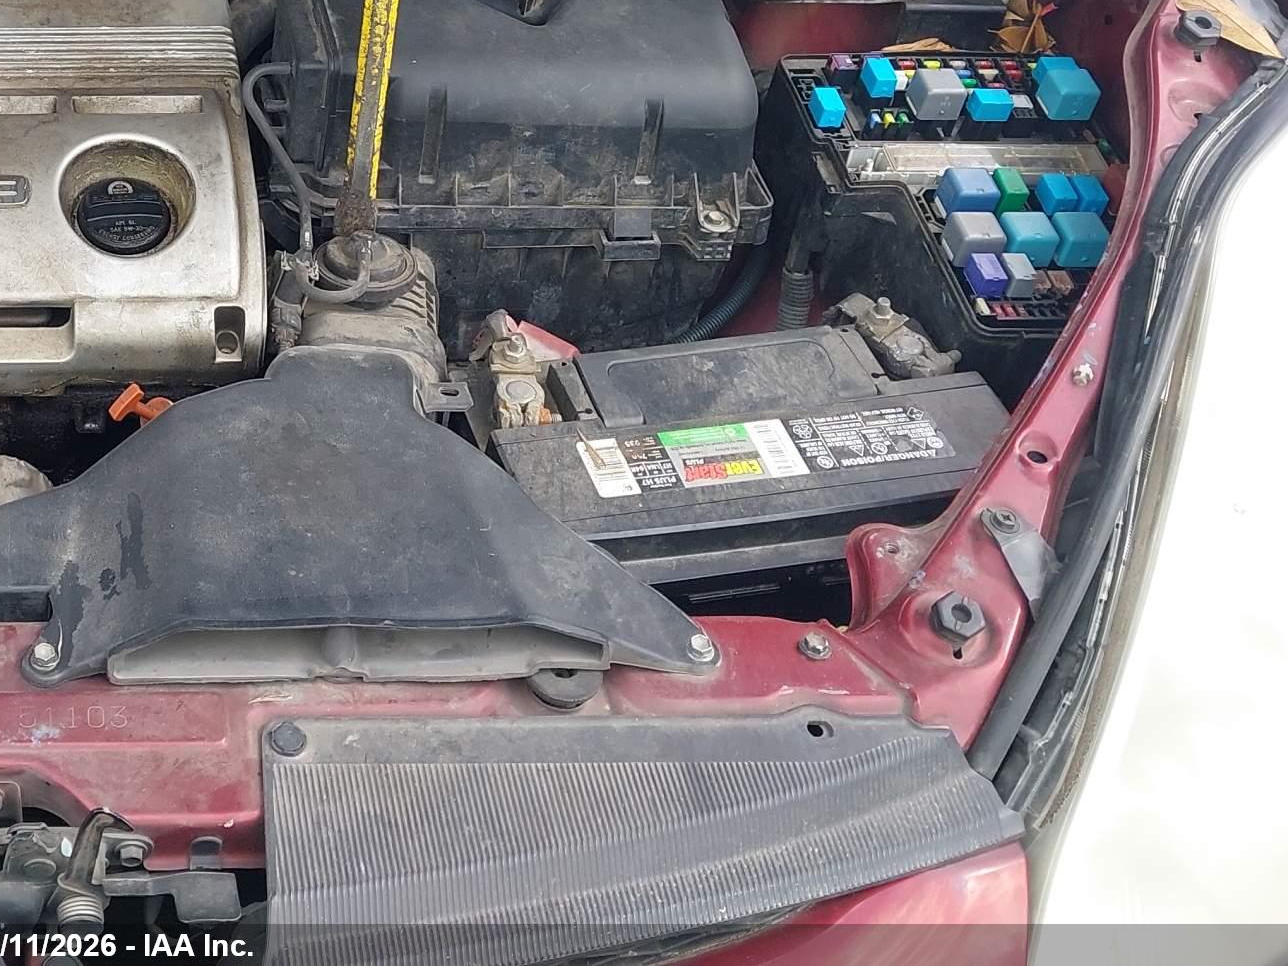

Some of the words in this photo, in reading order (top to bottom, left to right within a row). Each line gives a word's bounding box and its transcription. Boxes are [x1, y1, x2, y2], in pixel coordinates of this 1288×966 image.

[685, 458, 704, 466] PLUS
[841, 449, 928, 467] DANGER/POISON
[685, 458, 764, 482] EverStart
[642, 477, 655, 486] H7
[656, 475, 677, 485] PLUS
